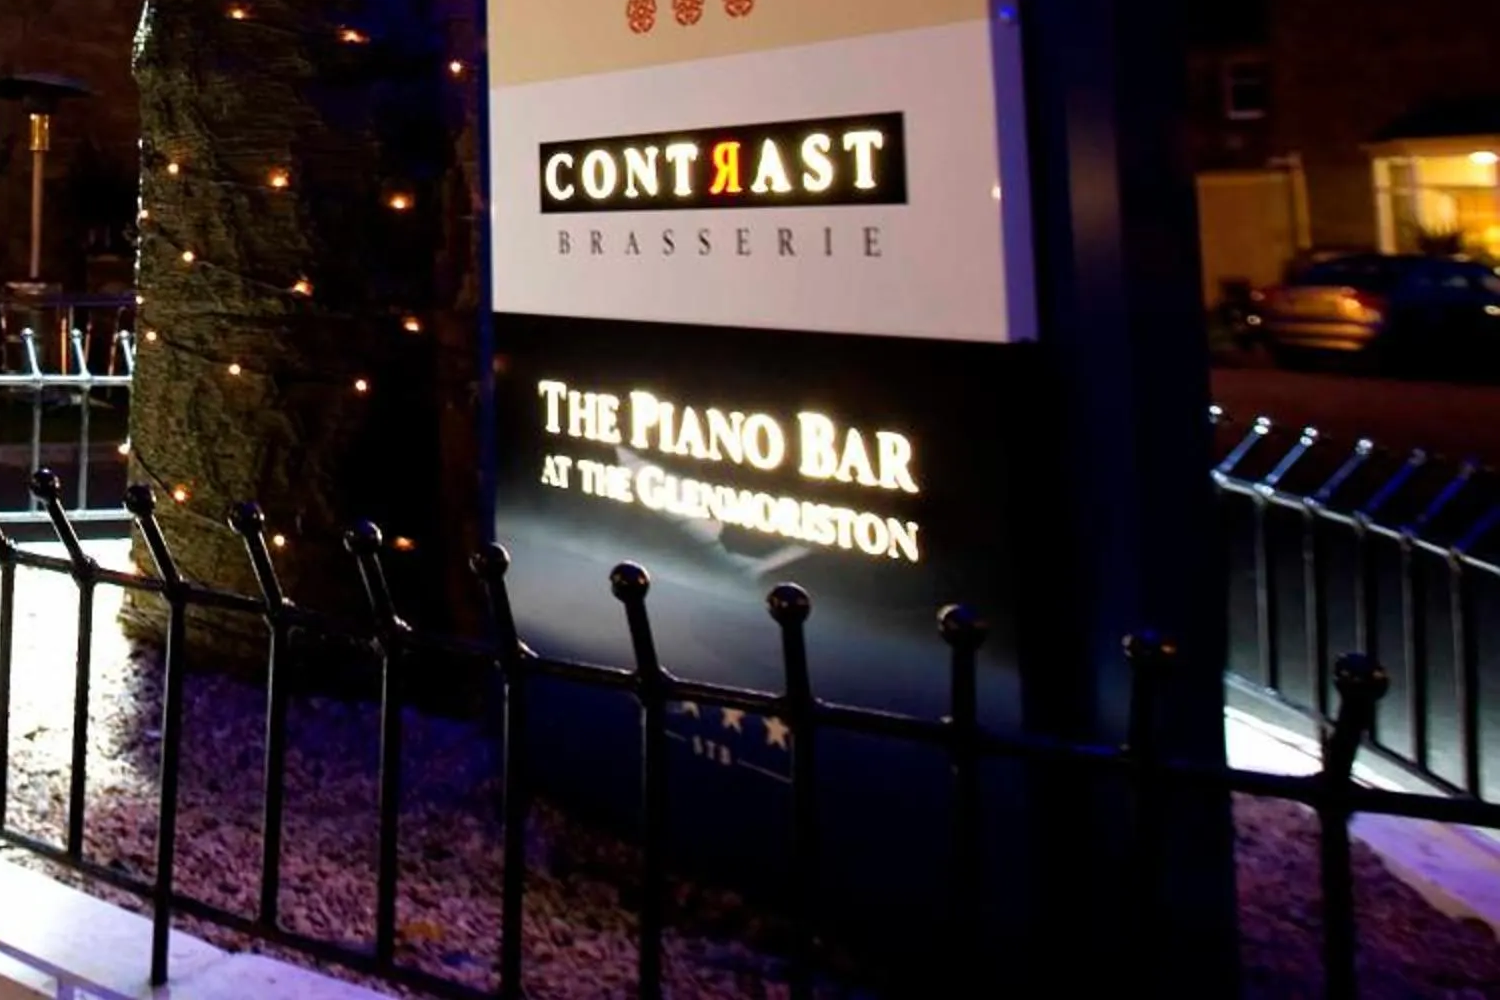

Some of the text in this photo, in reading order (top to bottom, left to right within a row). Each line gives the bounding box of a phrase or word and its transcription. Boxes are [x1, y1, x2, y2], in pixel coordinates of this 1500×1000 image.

[544, 128, 884, 201] CONTRAST
[558, 226, 884, 258] BRASSERIE
[540, 455, 920, 564] AT THE GLENMORISTON
